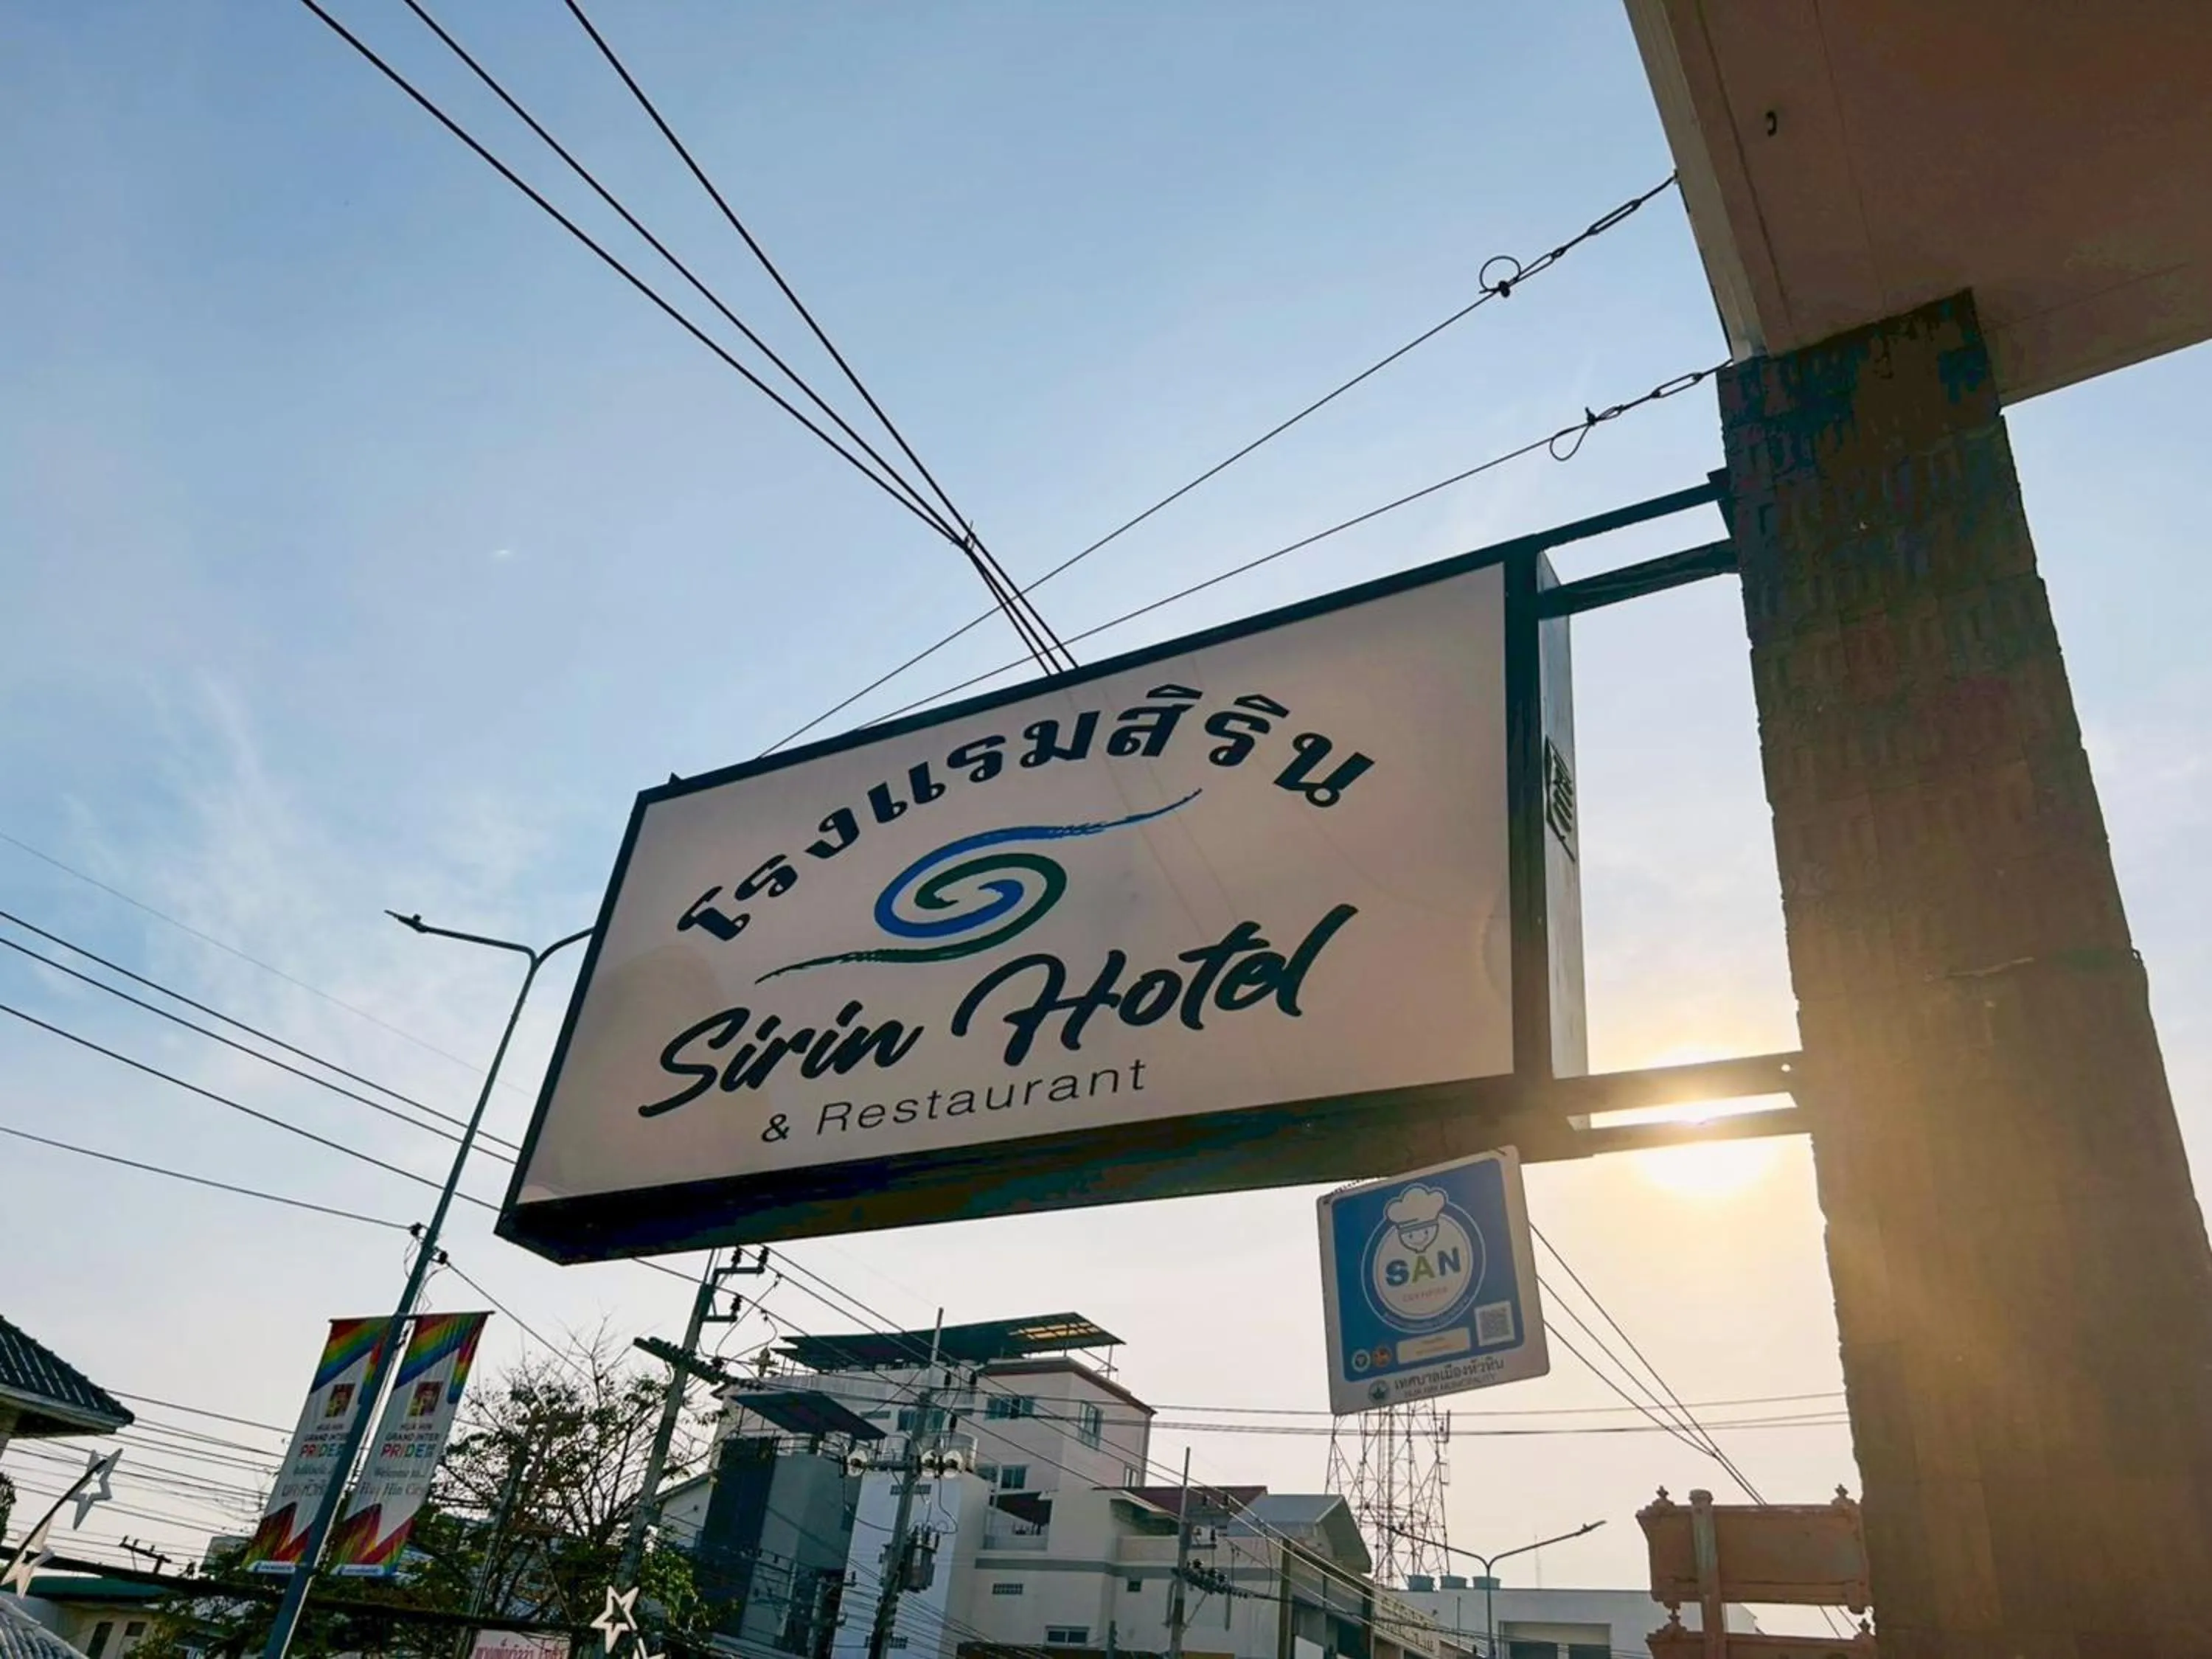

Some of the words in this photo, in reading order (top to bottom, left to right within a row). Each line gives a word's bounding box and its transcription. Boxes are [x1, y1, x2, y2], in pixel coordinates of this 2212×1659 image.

[676, 684, 1375, 942] โรงแรมสิริน
[638, 1000, 925, 1119] Sirin
[950, 903, 1359, 1067] Hotel
[761, 1113, 790, 1143] &
[816, 1059, 1147, 1135] Restaurant
[1385, 1247, 1461, 1286] SAN
[380, 1443, 426, 1457] PRIDE
